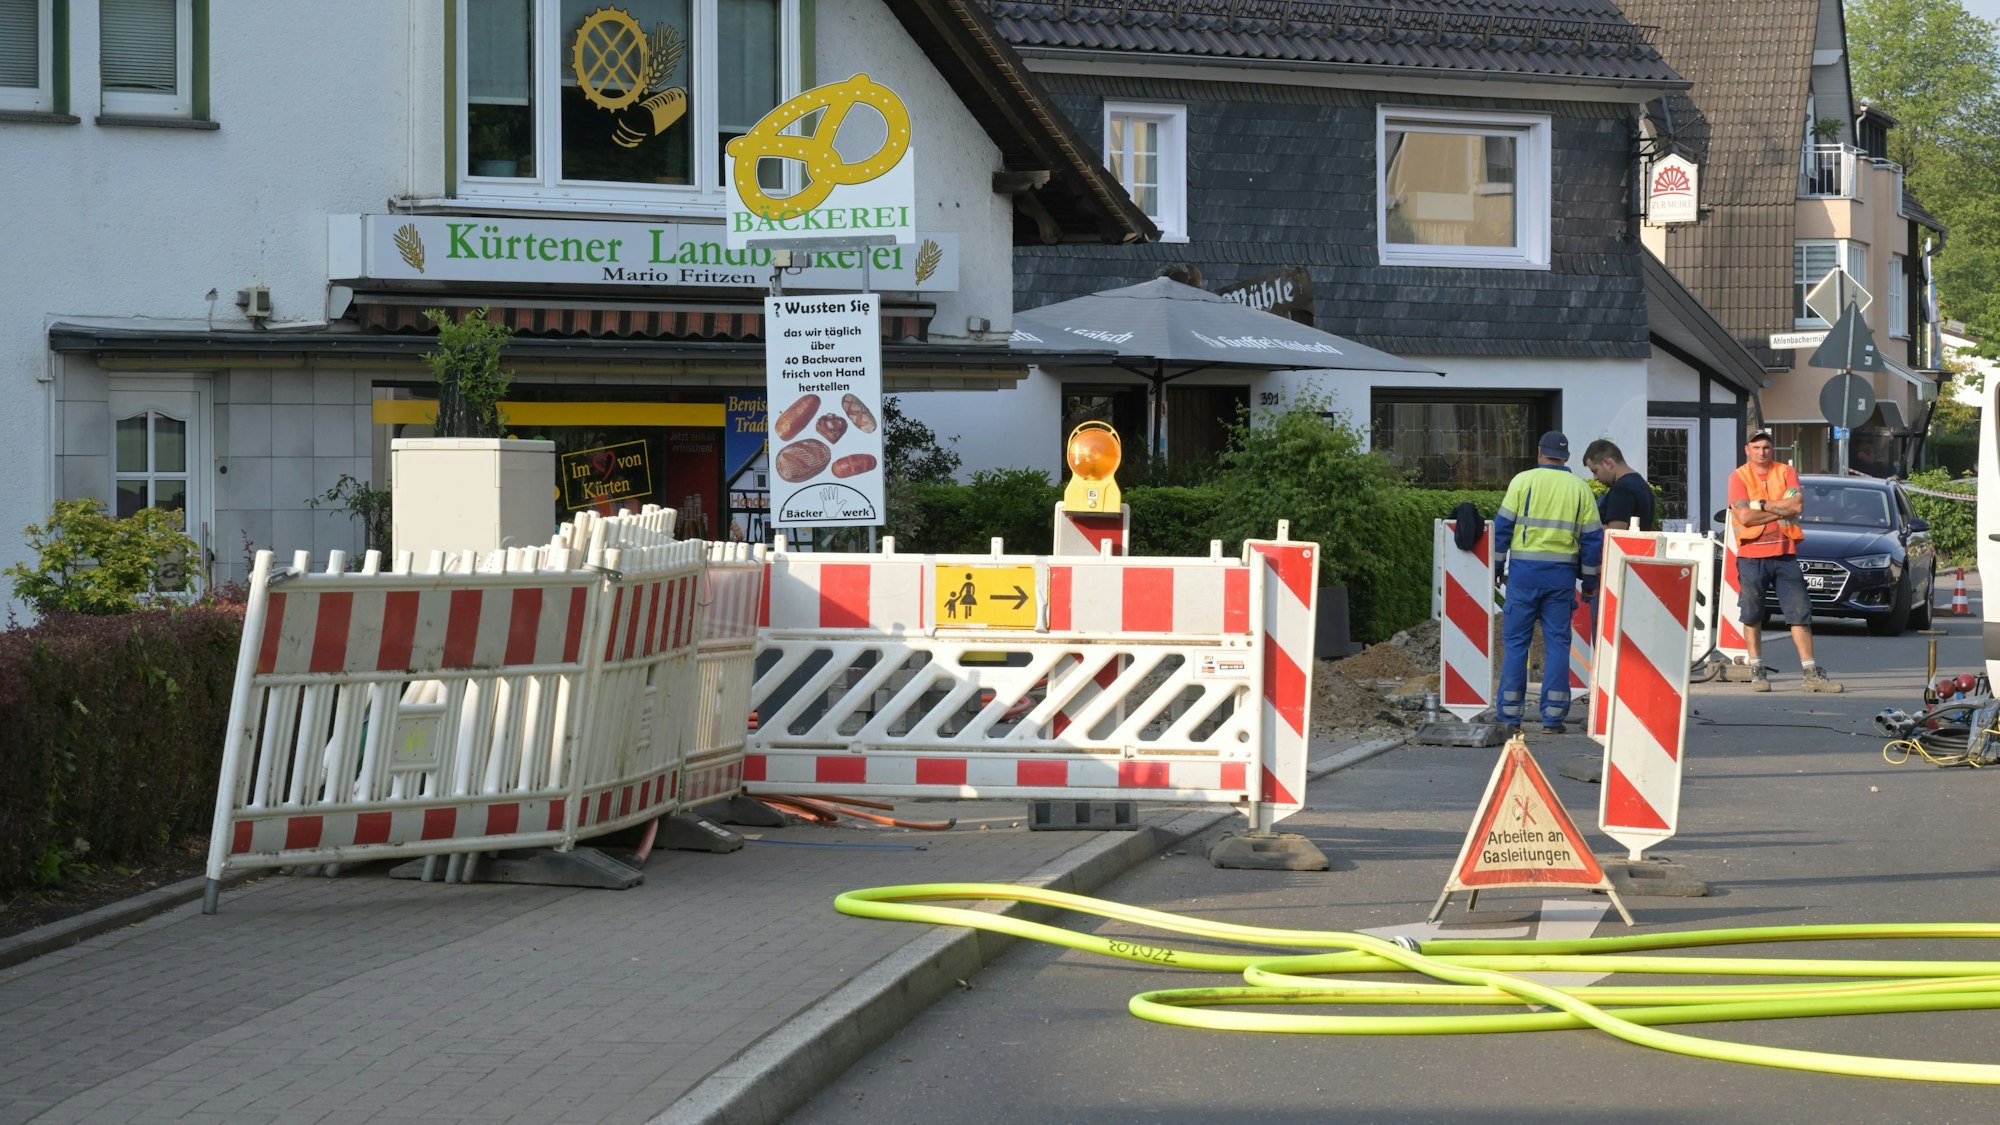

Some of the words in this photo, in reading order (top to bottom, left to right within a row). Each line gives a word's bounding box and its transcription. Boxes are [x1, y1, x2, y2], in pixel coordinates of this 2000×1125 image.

[733, 205, 910, 233] BÄCKEREI
[446, 223, 622, 263] Kürtener
[602, 267, 668, 282] Mario
[679, 268, 756, 284] Fritzen
[785, 302, 846, 314] Wussten
[850, 299, 870, 313] Sie
[783, 328, 802, 338] das
[805, 327, 822, 337] wir
[825, 326, 862, 338] täglich
[810, 341, 835, 350] über
[784, 356, 799, 365] 40
[802, 354, 862, 365] Backwaren
[782, 369, 810, 379] frisch
[813, 370, 833, 378] von
[836, 367, 865, 377] Hand
[798, 382, 850, 392] herstellen
[1260, 391, 1279, 406] 391
[728, 396, 768, 419] Bergis
[571, 462, 591, 479] Im
[617, 453, 643, 469] von
[583, 479, 631, 500] Kürten
[786, 509, 824, 518] Bäcker
[842, 508, 870, 517] werk
[1487, 829, 1544, 846] Arbeiten
[1548, 830, 1564, 842] an
[1483, 848, 1571, 866] Gasleitungen
